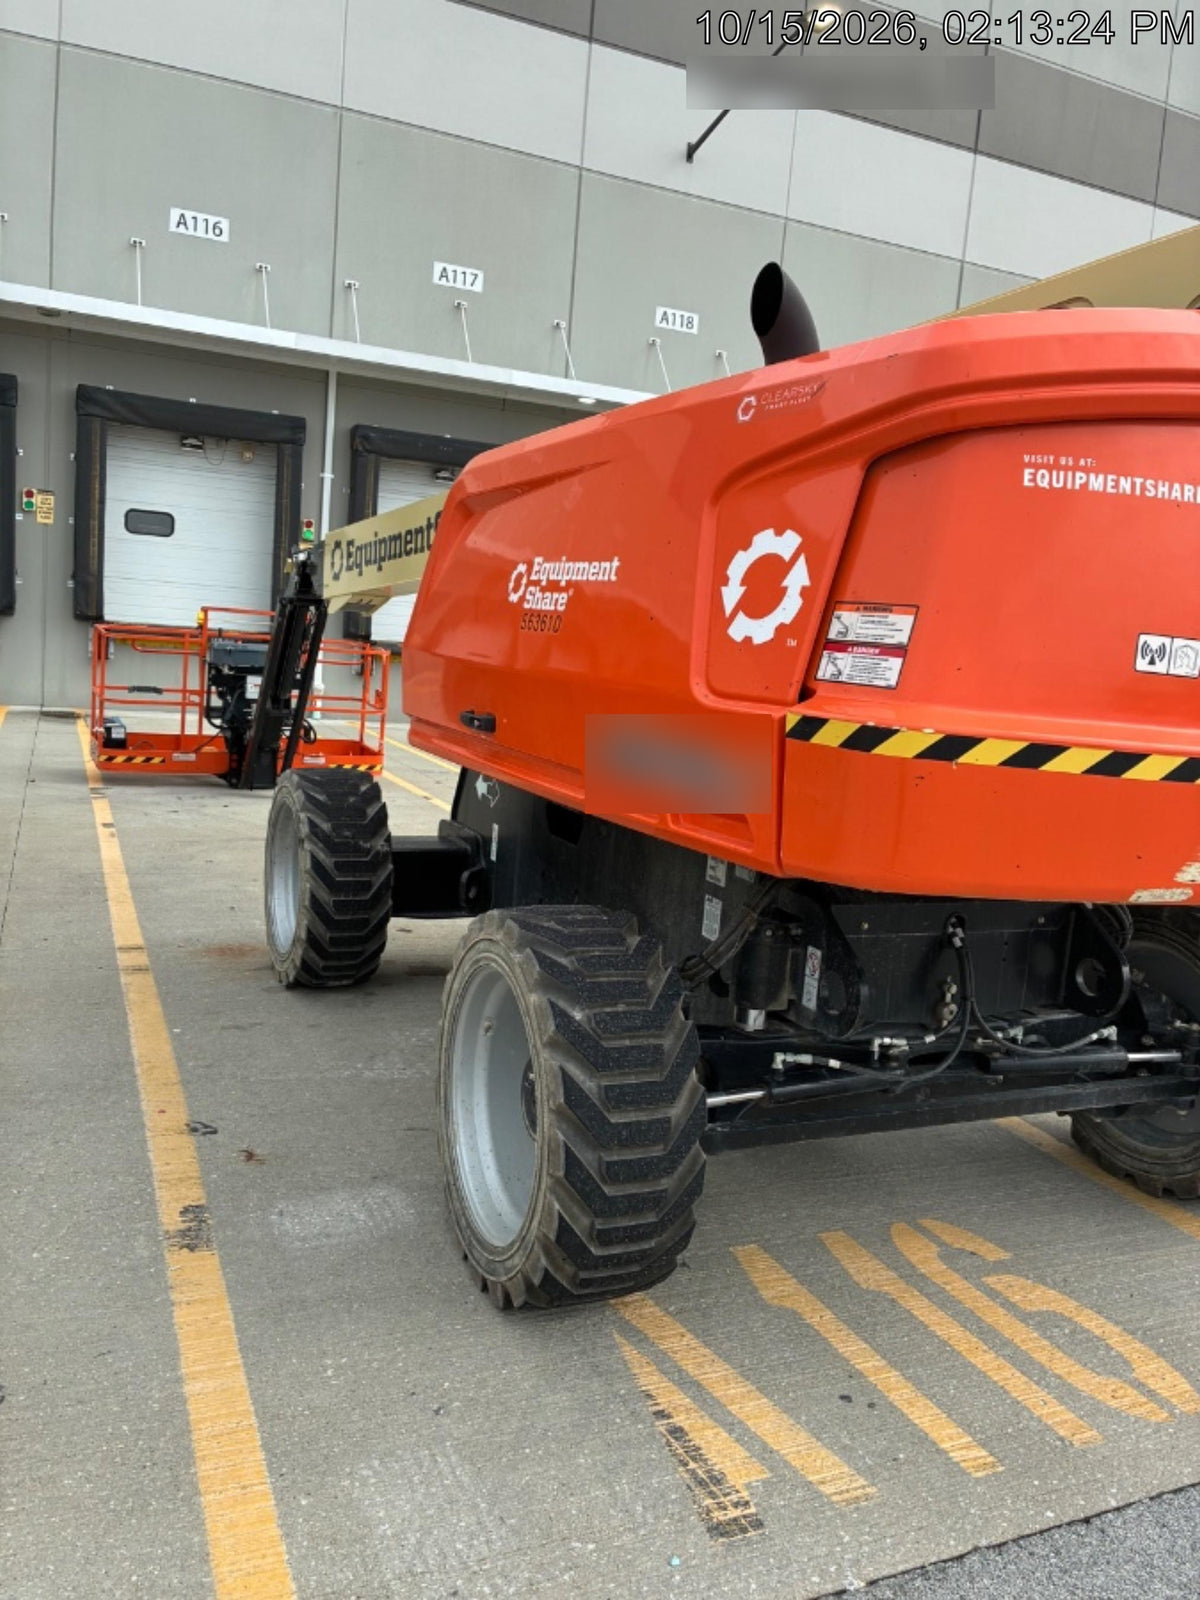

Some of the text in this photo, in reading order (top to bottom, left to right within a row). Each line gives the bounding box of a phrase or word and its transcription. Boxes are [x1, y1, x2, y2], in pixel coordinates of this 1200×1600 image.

[175, 212, 223, 238] A116
[438, 266, 479, 288] A117
[659, 310, 694, 330] A118
[1023, 454, 1097, 468] VISIT US AT:
[529, 555, 621, 588] Equipment
[523, 585, 569, 612] Share
